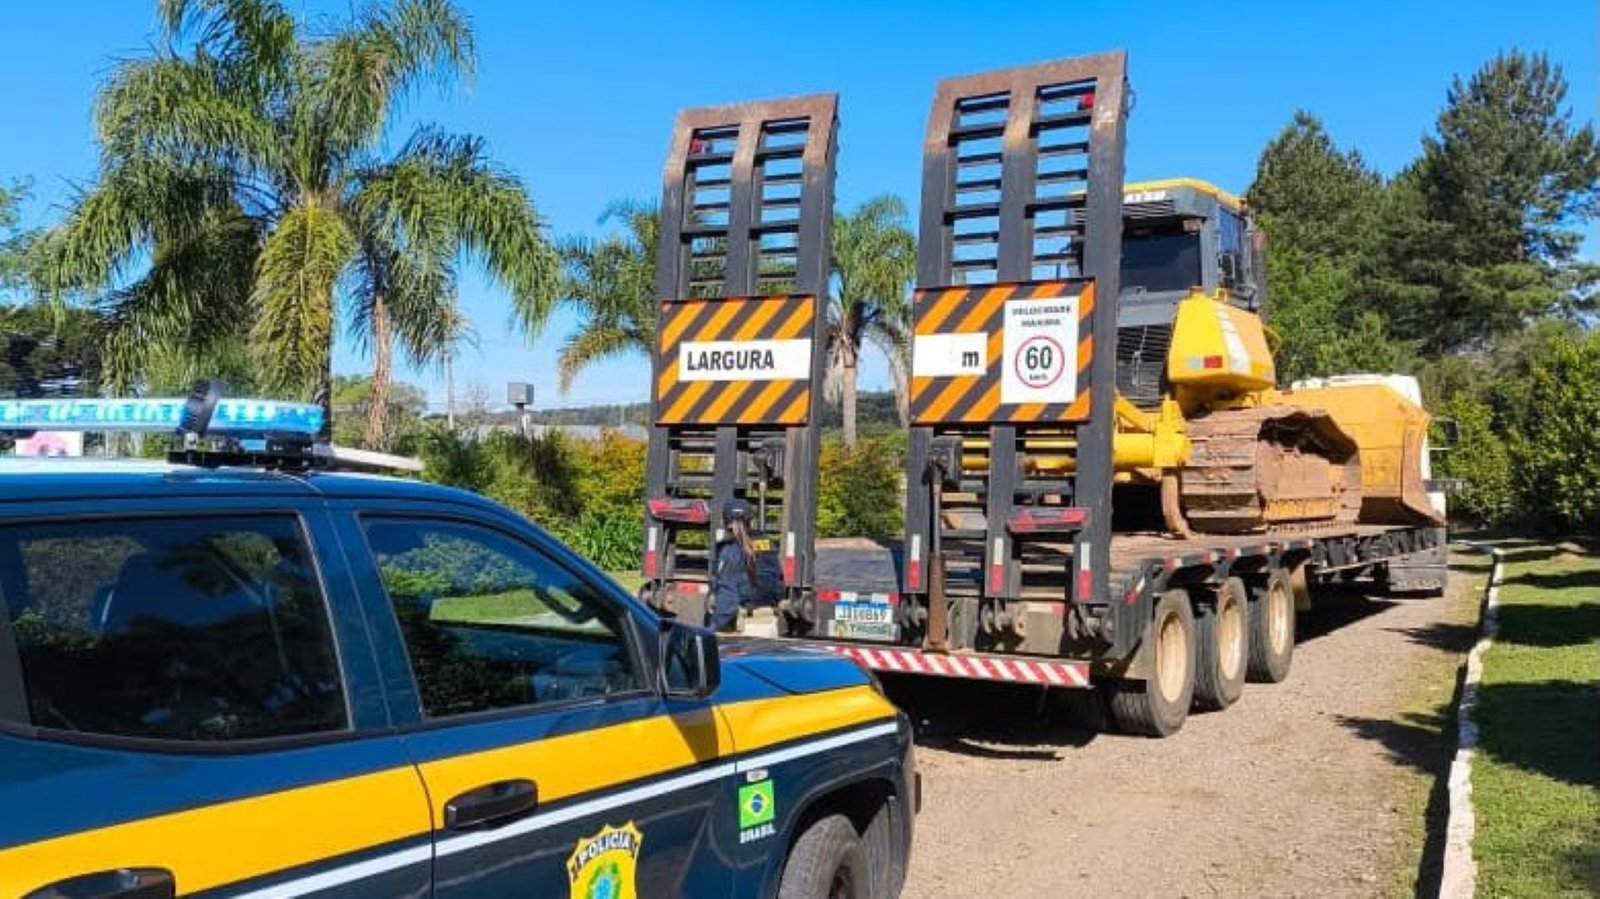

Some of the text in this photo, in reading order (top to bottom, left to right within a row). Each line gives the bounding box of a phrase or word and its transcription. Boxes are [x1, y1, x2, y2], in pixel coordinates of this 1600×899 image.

[687, 349, 775, 371] LARGURA
[962, 351, 979, 368] m
[1025, 345, 1053, 370] 60
[740, 822, 777, 844] BRASIL
